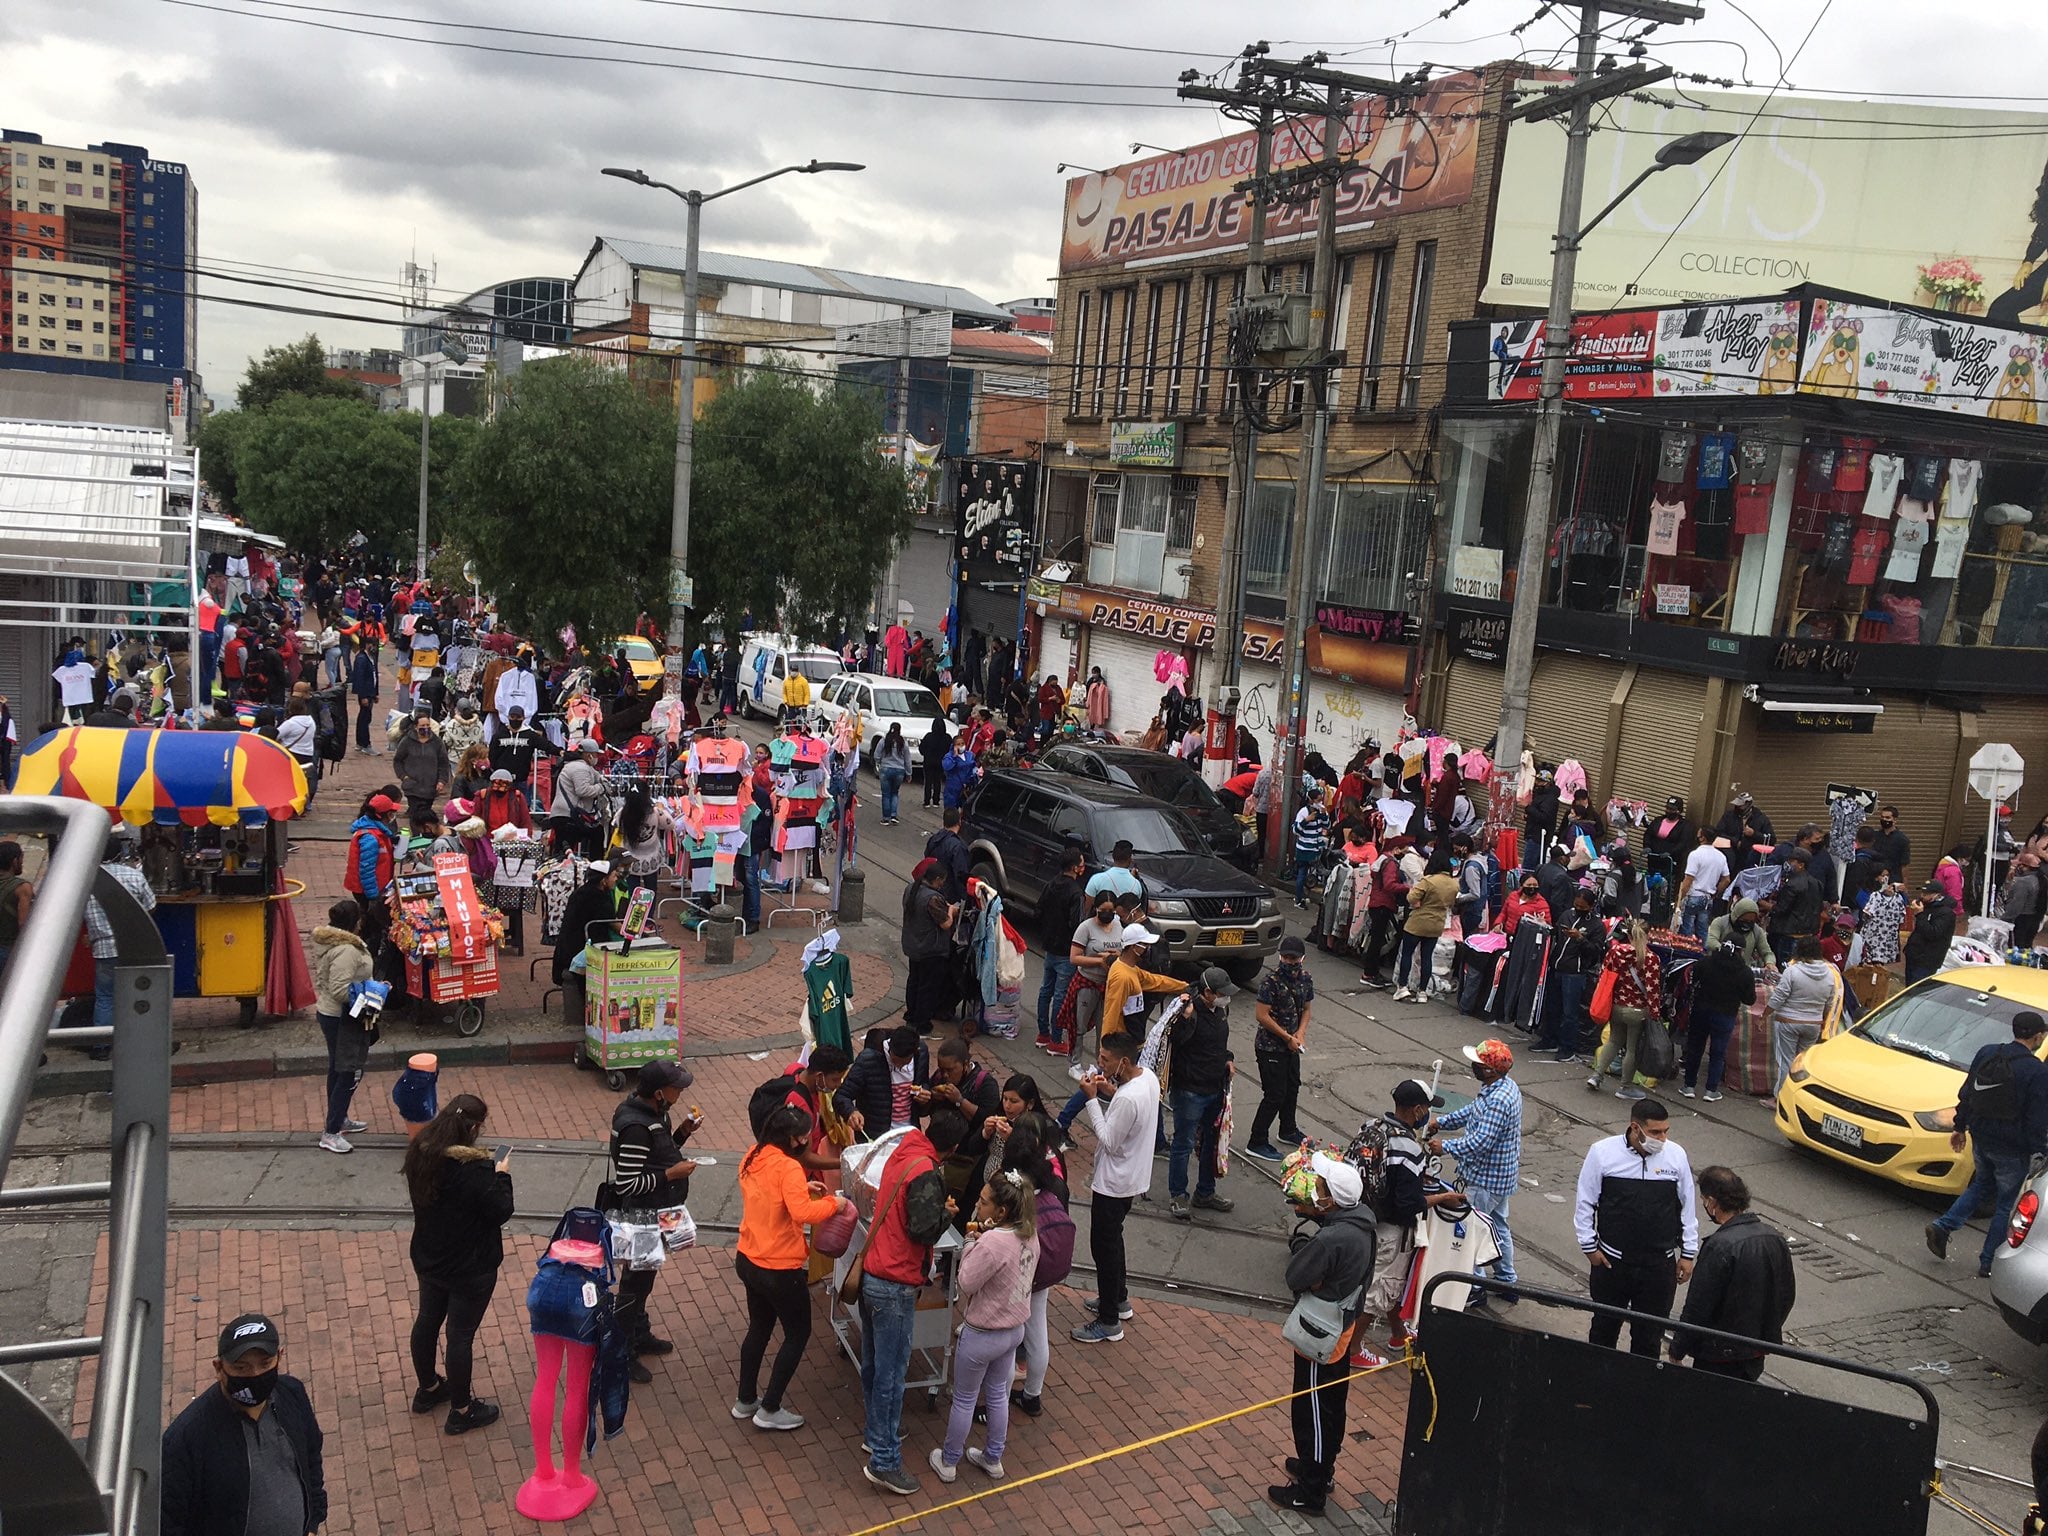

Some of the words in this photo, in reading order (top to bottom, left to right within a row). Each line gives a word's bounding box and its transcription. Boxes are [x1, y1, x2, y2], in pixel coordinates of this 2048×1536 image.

[1126, 149, 1214, 199] CENTRO
[1102, 192, 1250, 255] PASAJE
[1705, 305, 1763, 343] Aber
[463, 334, 486, 346] GRAN
[1668, 351, 1680, 359] 301
[1682, 350, 1694, 358] 777
[1695, 349, 1712, 358] 0346
[1877, 350, 1890, 359] 301
[1890, 351, 1903, 361] 777
[1904, 354, 1920, 363] 0346
[1573, 364, 1606, 375] HOMBRE
[1608, 364, 1614, 373] Y
[1681, 360, 1693, 368] 746
[1694, 359, 1711, 368] 4636
[1875, 362, 1888, 370] 300
[1889, 363, 1901, 372] 746
[1902, 365, 1918, 375] 4636
[1113, 442, 1137, 456] VIEJO
[1138, 444, 1170, 457] CALDAS
[1454, 577, 1467, 593] 321
[1468, 579, 1481, 595] 207
[1127, 599, 1171, 616] CENTRO
[1667, 604, 1676, 612] 207
[1090, 603, 1191, 644] PASAJE
[1327, 608, 1384, 641] Marvy
[1728, 643, 1736, 651] 10
[1774, 641, 1816, 670] Aber
[436, 855, 463, 866] Claro
[449, 878, 475, 959] MINUTOS
